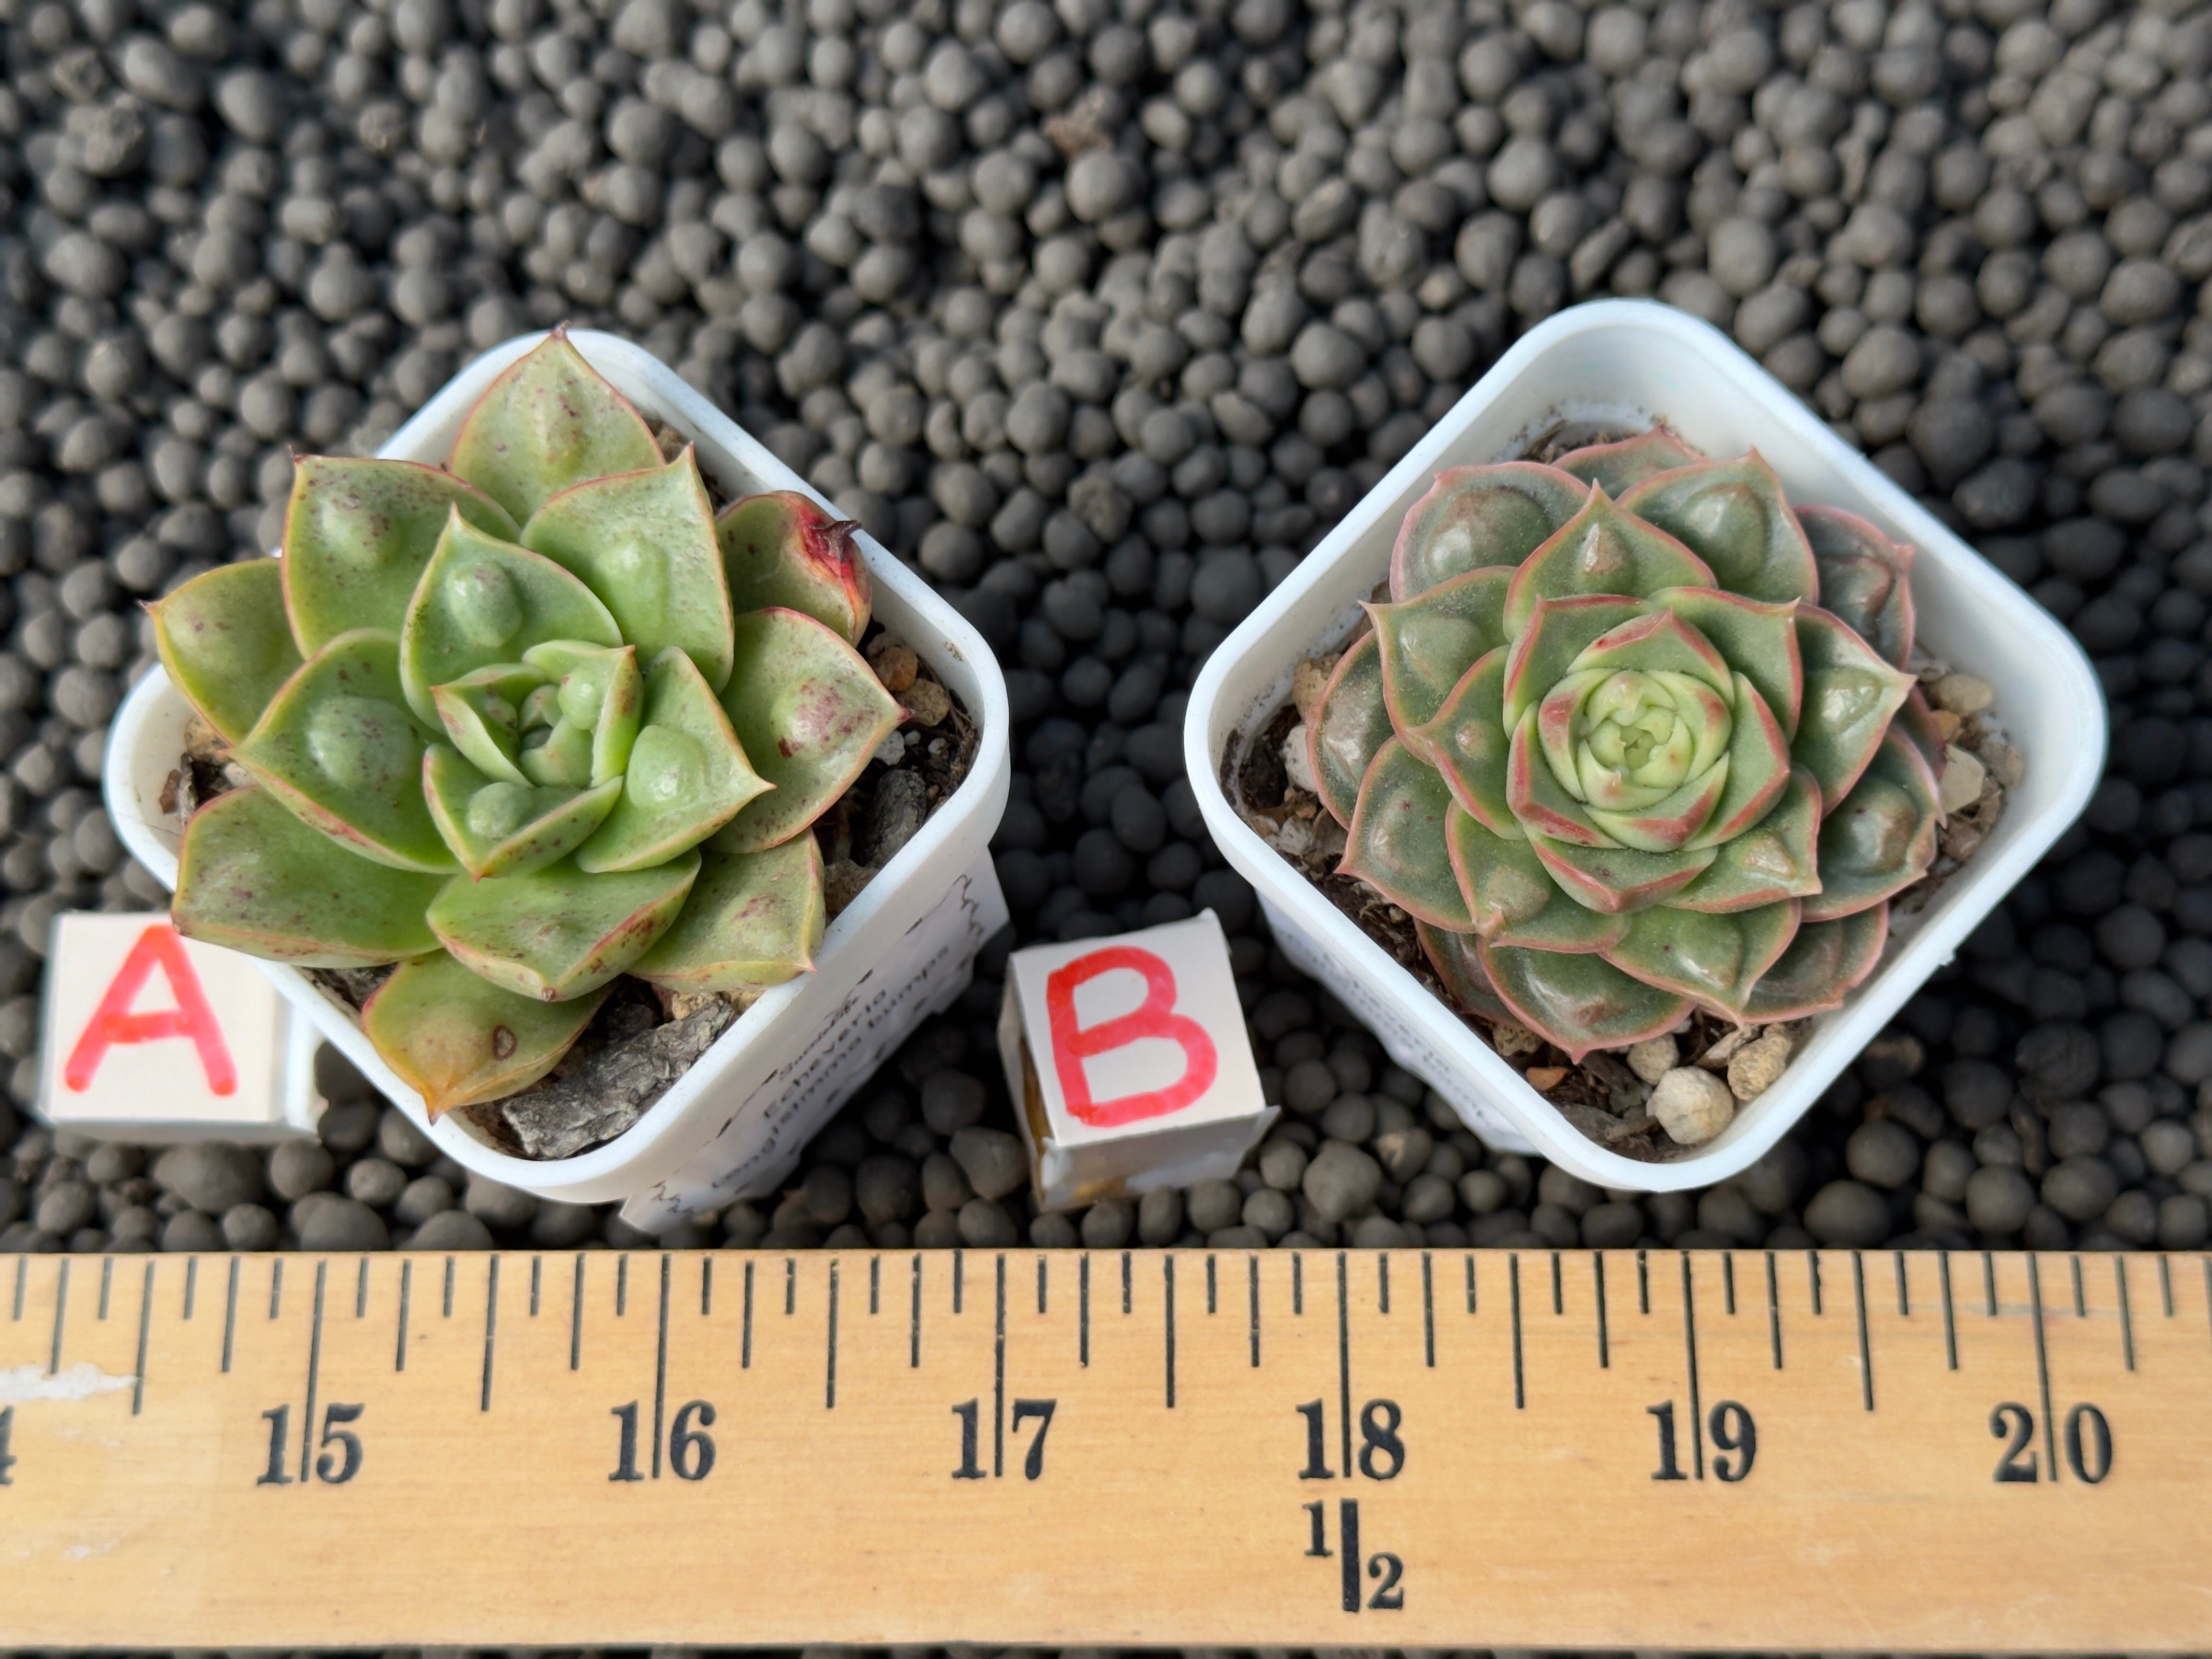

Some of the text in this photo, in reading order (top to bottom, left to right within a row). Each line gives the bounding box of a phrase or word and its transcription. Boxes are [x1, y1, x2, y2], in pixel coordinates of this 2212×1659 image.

[65, 923, 239, 1099] A
[1046, 944, 1218, 1128] B
[257, 1397, 2113, 1484] 15 16 17 18 19 20
